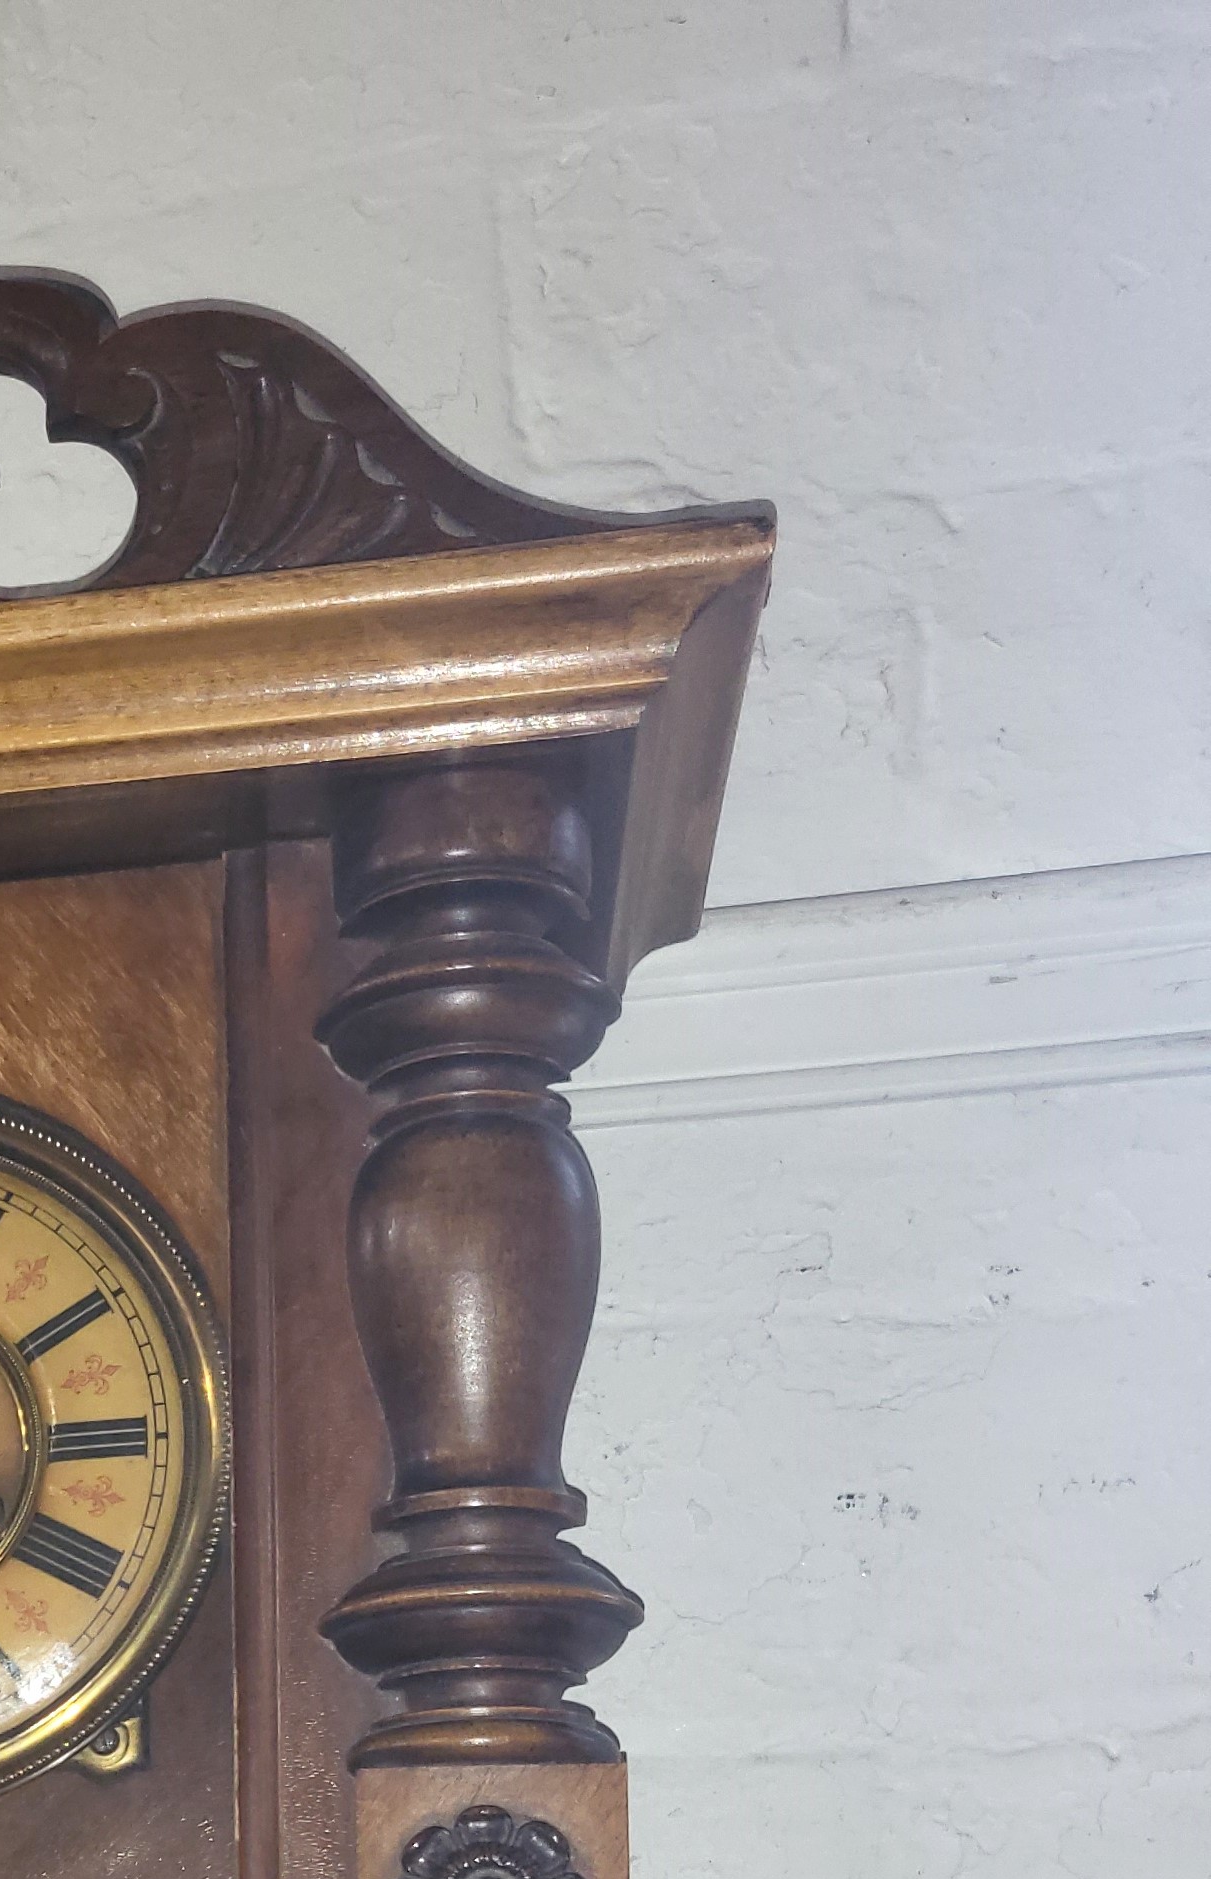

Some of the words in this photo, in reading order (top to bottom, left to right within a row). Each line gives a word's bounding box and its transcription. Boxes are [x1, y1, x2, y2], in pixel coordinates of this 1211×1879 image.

[16, 1285, 114, 1363] II
[47, 1415, 148, 1464] III
[12, 1512, 127, 1600] IIII
